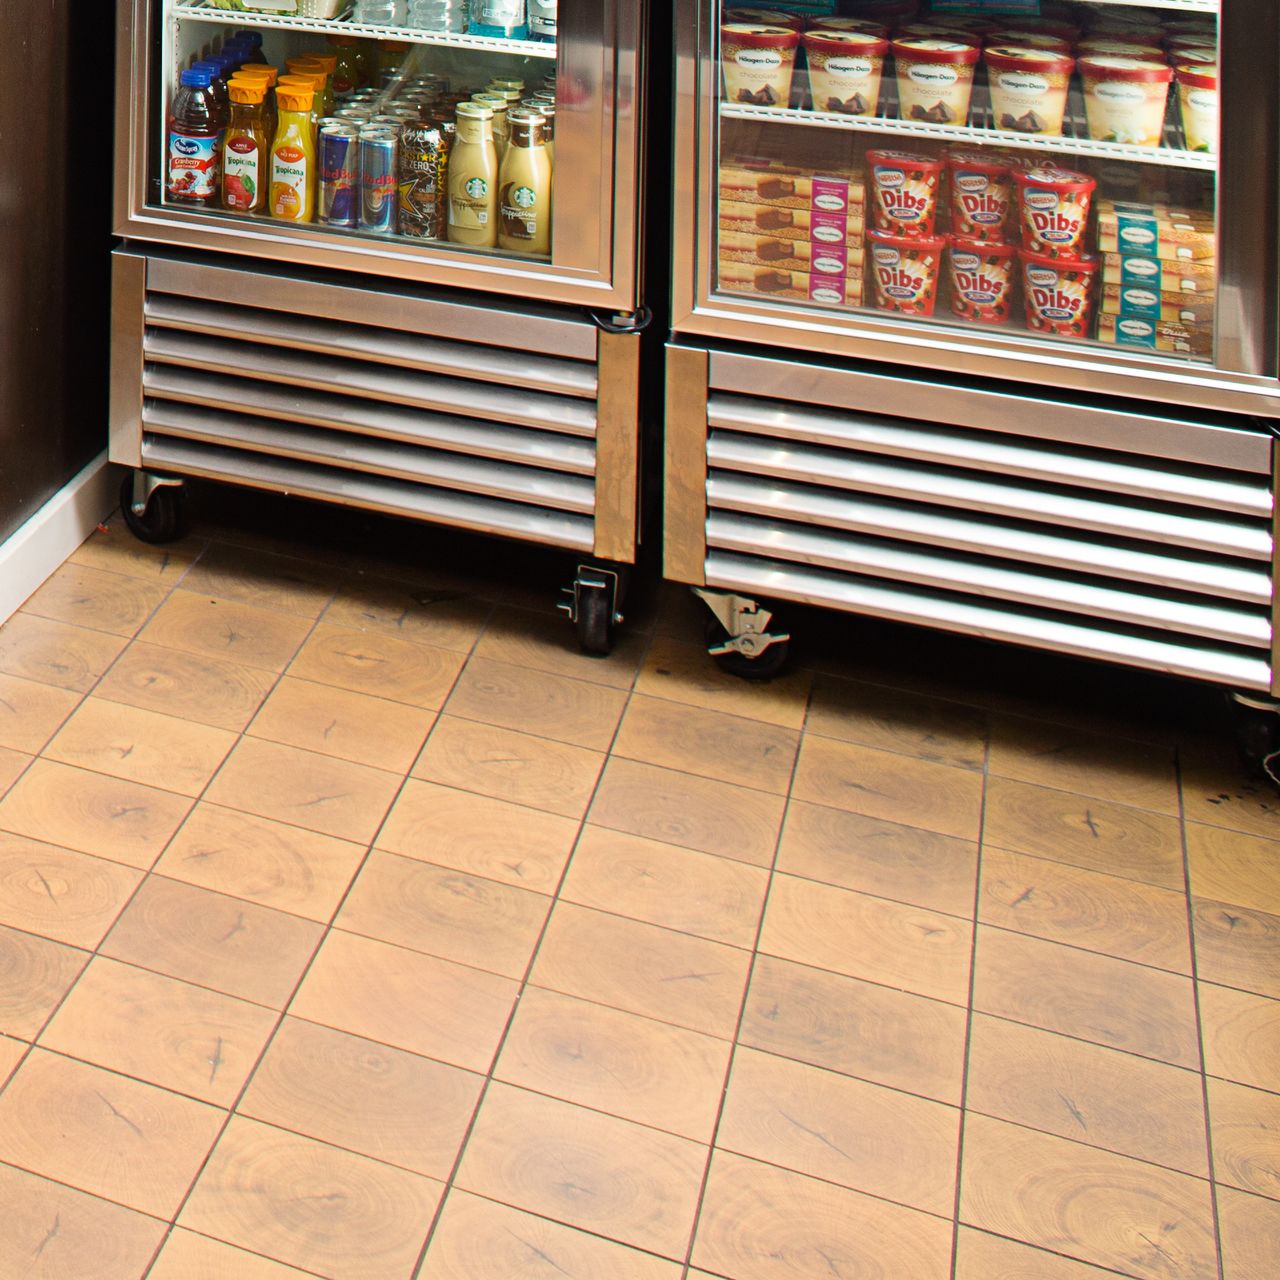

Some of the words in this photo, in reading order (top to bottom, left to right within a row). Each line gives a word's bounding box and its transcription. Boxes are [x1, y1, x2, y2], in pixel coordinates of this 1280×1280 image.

[227, 156, 257, 168] Tropicana
[274, 165, 304, 176] Tropicana
[409, 161, 429, 170] ZERO
[880, 187, 928, 211] Dibs
[961, 193, 1008, 215] Dibs
[1031, 209, 1081, 233] Dibs
[877, 267, 925, 291] Dibs
[955, 272, 1004, 295] Dibs
[1032, 288, 1082, 313] Dibs
